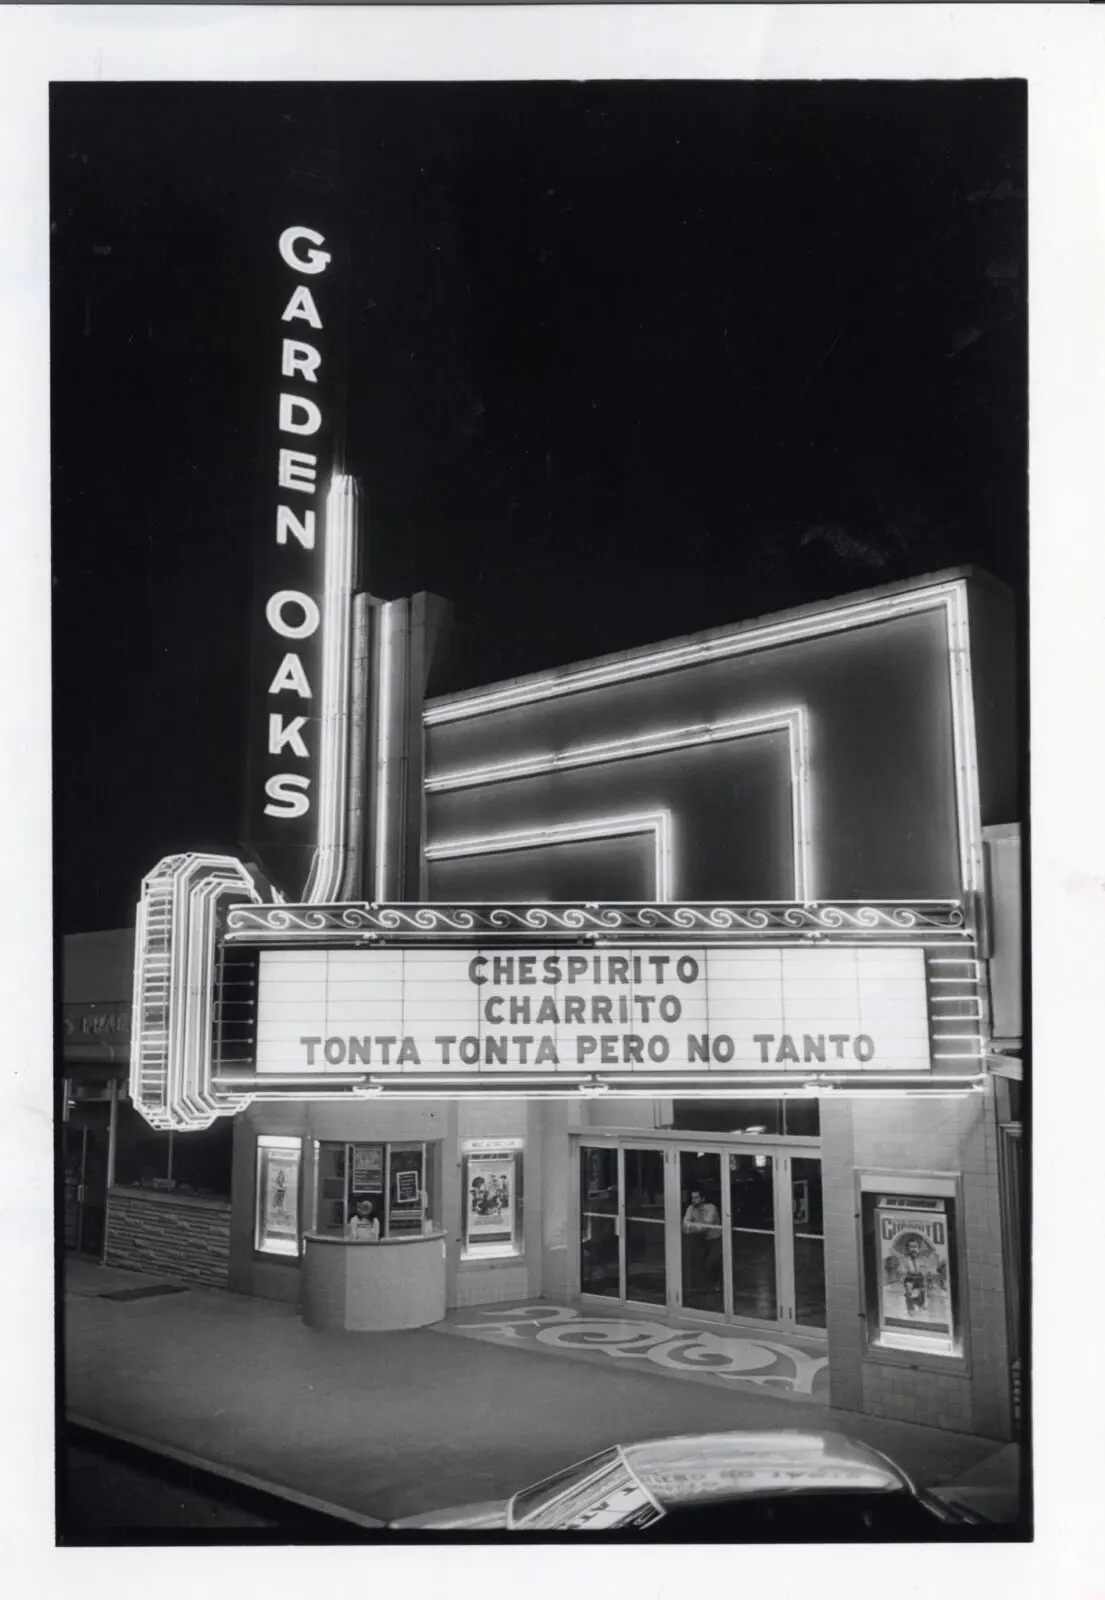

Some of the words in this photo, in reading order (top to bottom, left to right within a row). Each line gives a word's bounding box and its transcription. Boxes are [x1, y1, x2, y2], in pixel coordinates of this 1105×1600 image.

[276, 226, 332, 548] GARDEN
[263, 590, 320, 818] OAKS
[468, 955, 699, 985] CHESPIRITO
[484, 995, 682, 1024] CHARRITO
[301, 1036, 421, 1065] TONTA
[435, 1035, 560, 1065] TONTA
[576, 1034, 670, 1064] PERO
[687, 1034, 735, 1063] NO
[753, 1034, 875, 1063] TANTO
